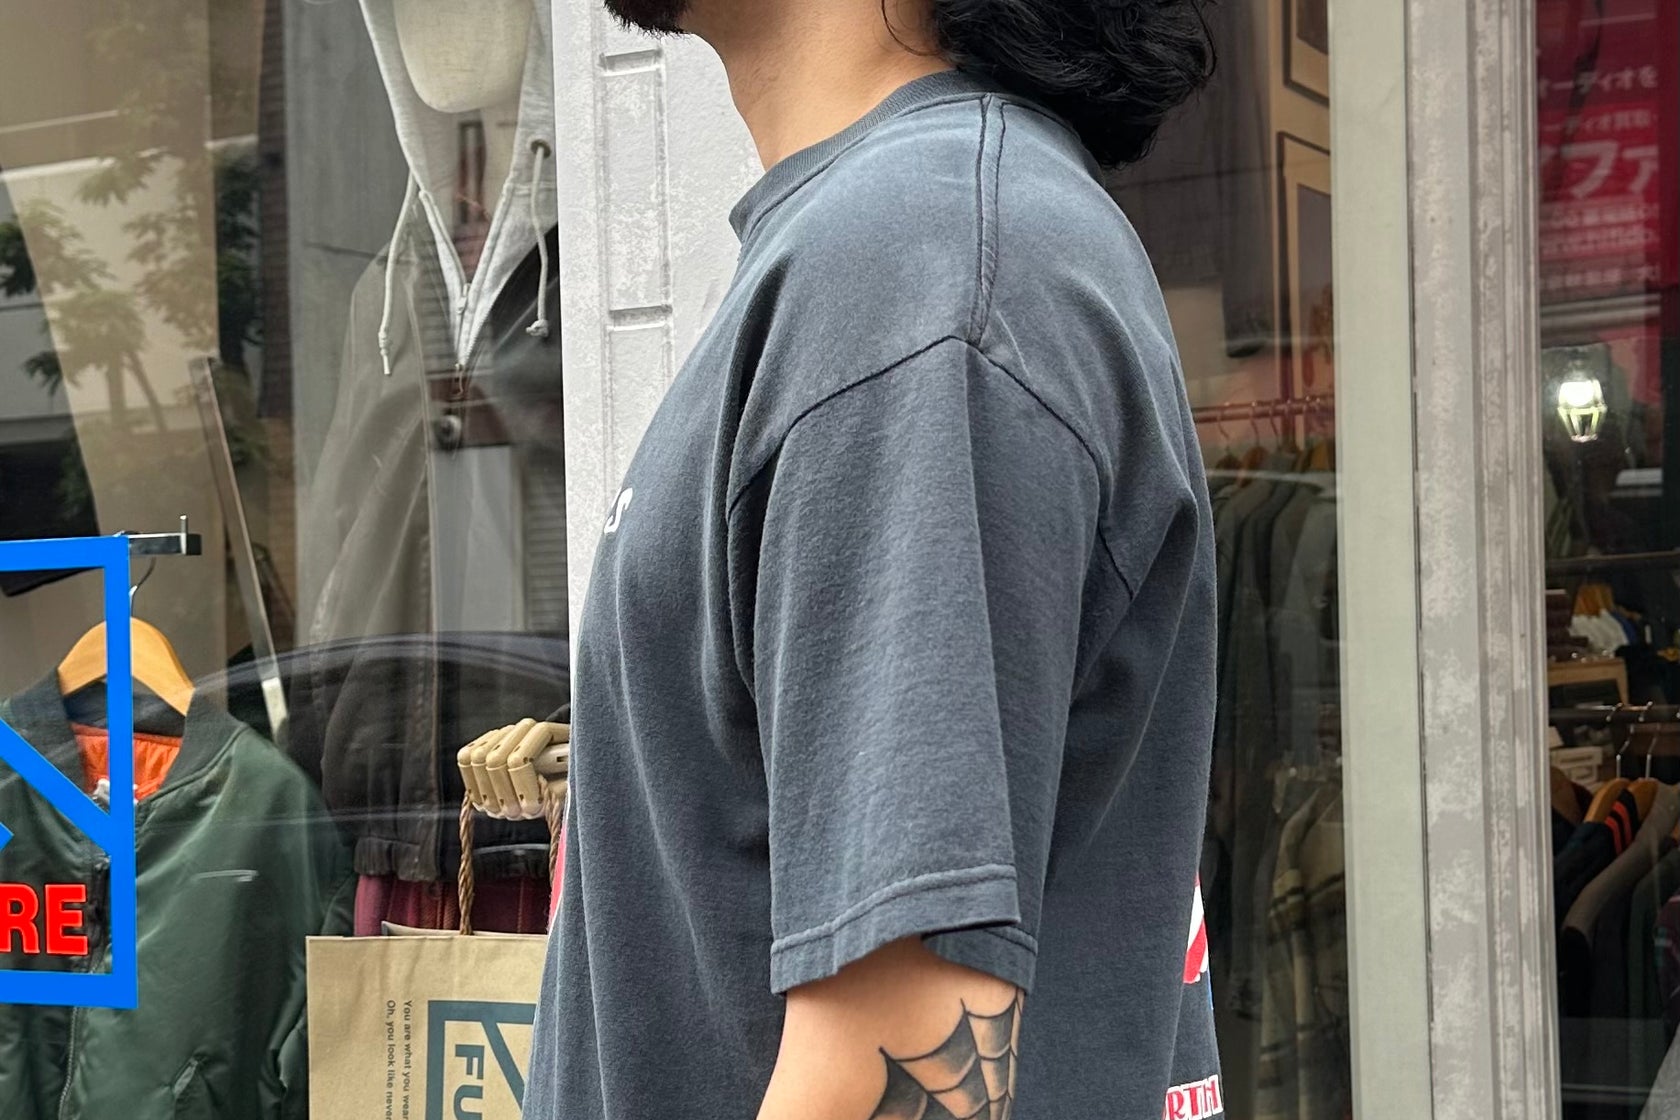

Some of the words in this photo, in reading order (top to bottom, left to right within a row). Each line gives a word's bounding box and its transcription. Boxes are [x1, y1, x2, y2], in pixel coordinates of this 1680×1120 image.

[0, 883, 88, 955] RE
[385, 1000, 397, 1018] Oh,
[403, 1000, 412, 1020] You
[385, 1021, 394, 1040] you
[387, 1044, 396, 1067] look
[404, 1043, 413, 1068] what
[386, 1070, 395, 1088] like
[402, 1072, 410, 1091] you
[385, 1092, 393, 1120] never
